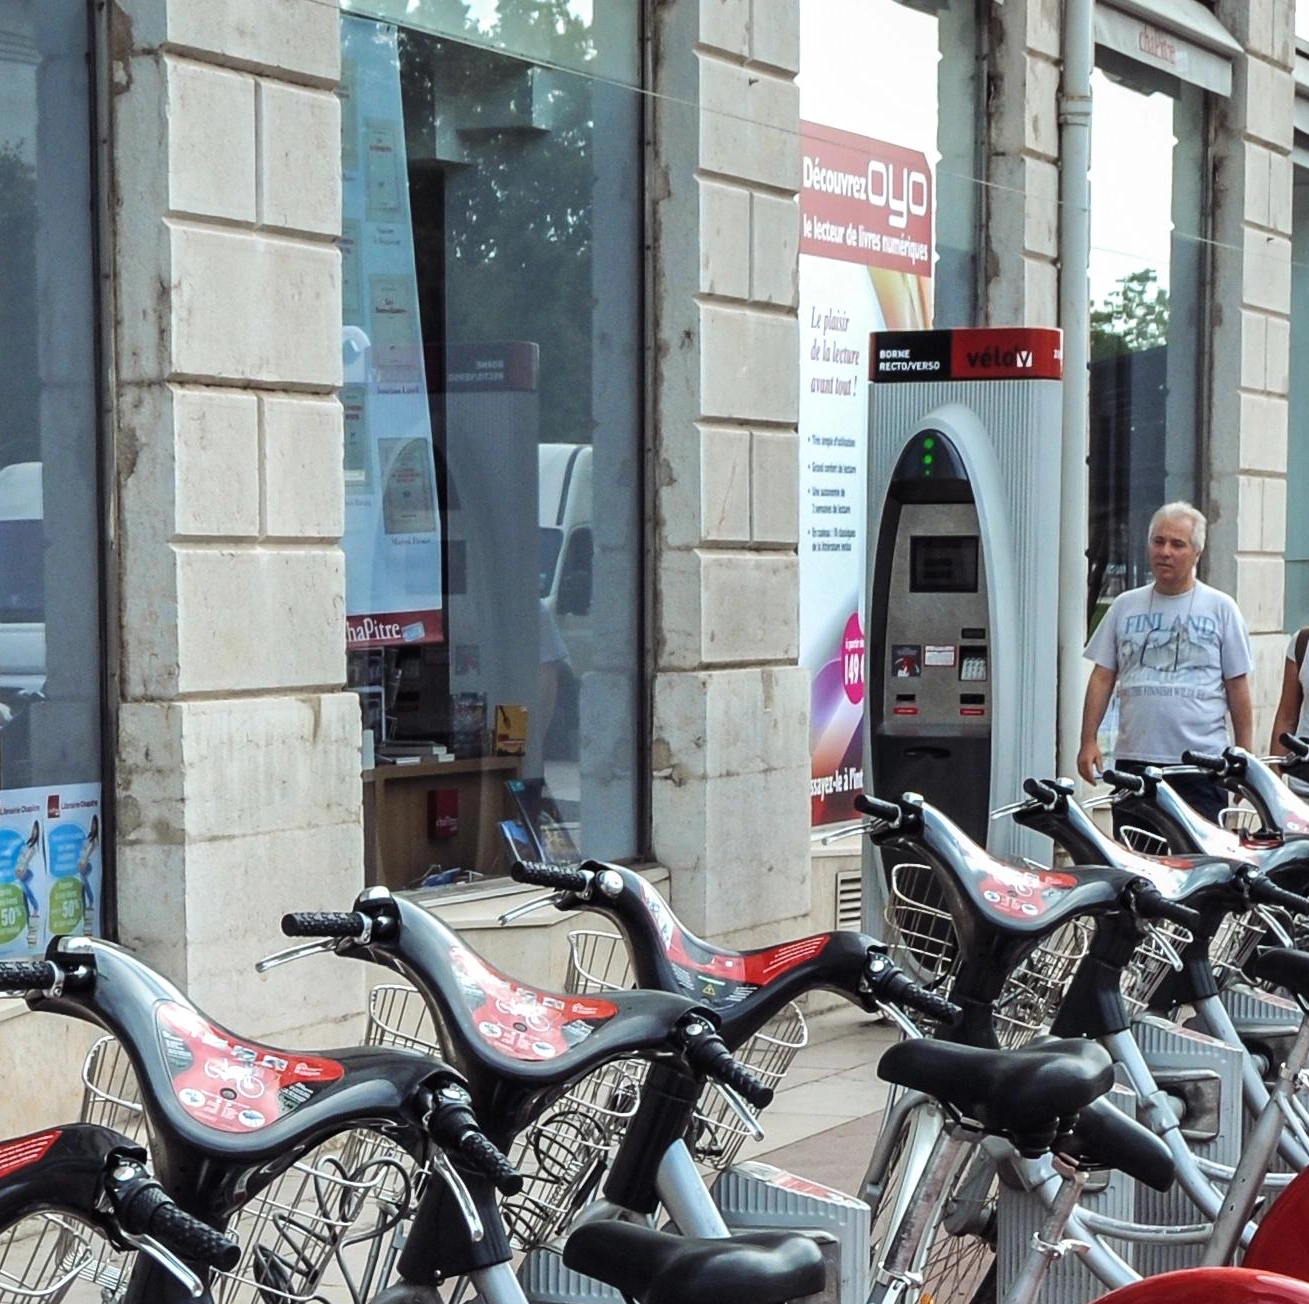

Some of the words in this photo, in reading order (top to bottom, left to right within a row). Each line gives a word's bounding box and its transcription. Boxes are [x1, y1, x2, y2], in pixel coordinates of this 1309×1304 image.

[803, 156, 867, 200] Découvrez
[803, 213, 812, 238] le
[813, 215, 845, 243] lecteur
[846, 222, 858, 248] de
[858, 225, 881, 251] livres
[882, 232, 928, 266] numériques
[811, 306, 821, 328] Le
[823, 308, 849, 336] plaisir
[811, 338, 820, 360] de
[823, 339, 830, 362] la
[832, 340, 860, 366] lecture
[879, 350, 910, 359] BORNE
[879, 361, 940, 371] RECTO/VERSO
[811, 377, 833, 394] avant
[835, 377, 851, 396] tout
[346, 617, 401, 642] haPitre
[1124, 613, 1216, 640] FINLAND
[845, 653, 859, 685] 149
[811, 768, 843, 802] ssayez-le
